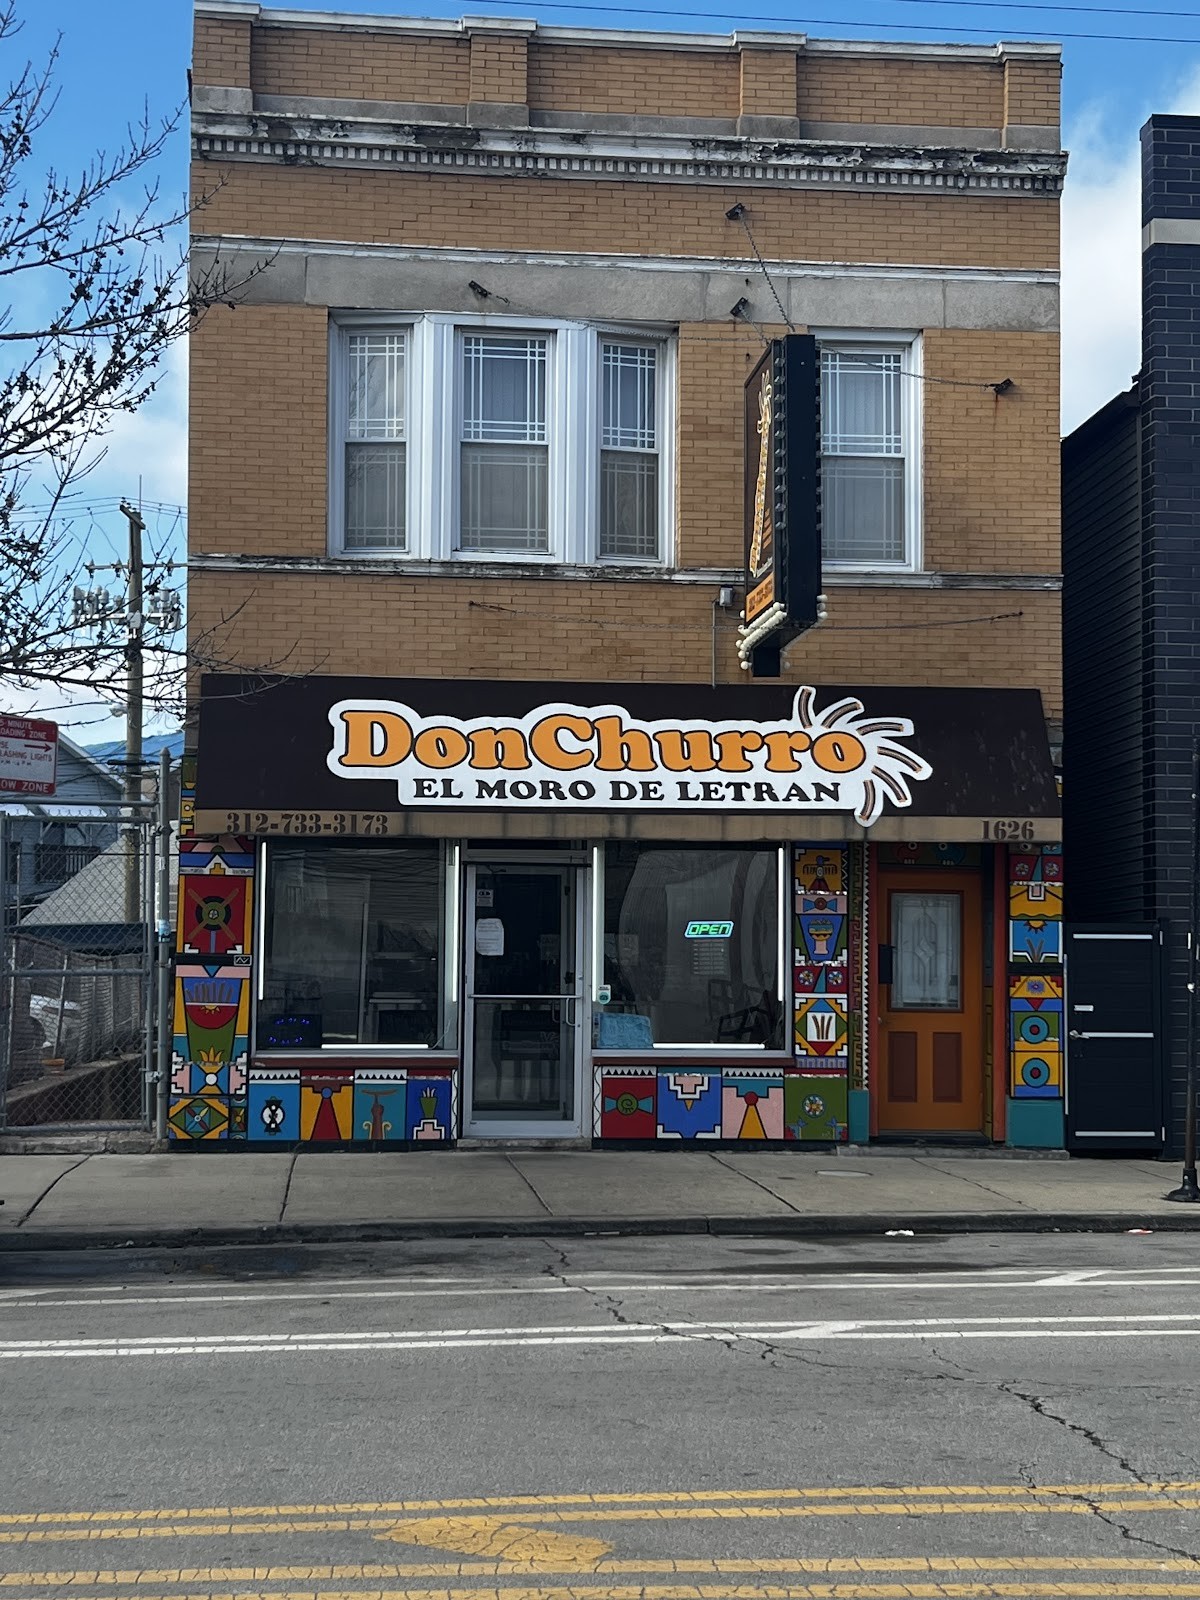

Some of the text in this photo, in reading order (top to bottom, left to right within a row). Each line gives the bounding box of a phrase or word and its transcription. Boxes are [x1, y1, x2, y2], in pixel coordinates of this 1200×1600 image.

[7, 720, 33, 730] MINUTE
[0, 728, 47, 740] OADING ZONE
[0, 750, 53, 762] LASHING LIGHTS
[0, 780, 49, 793] OW ZONE
[413, 778, 841, 802] EL MORO DE LETRAN
[226, 812, 389, 835] 312-733-3173
[981, 820, 1035, 841] 1626
[688, 924, 731, 935] OPEN
